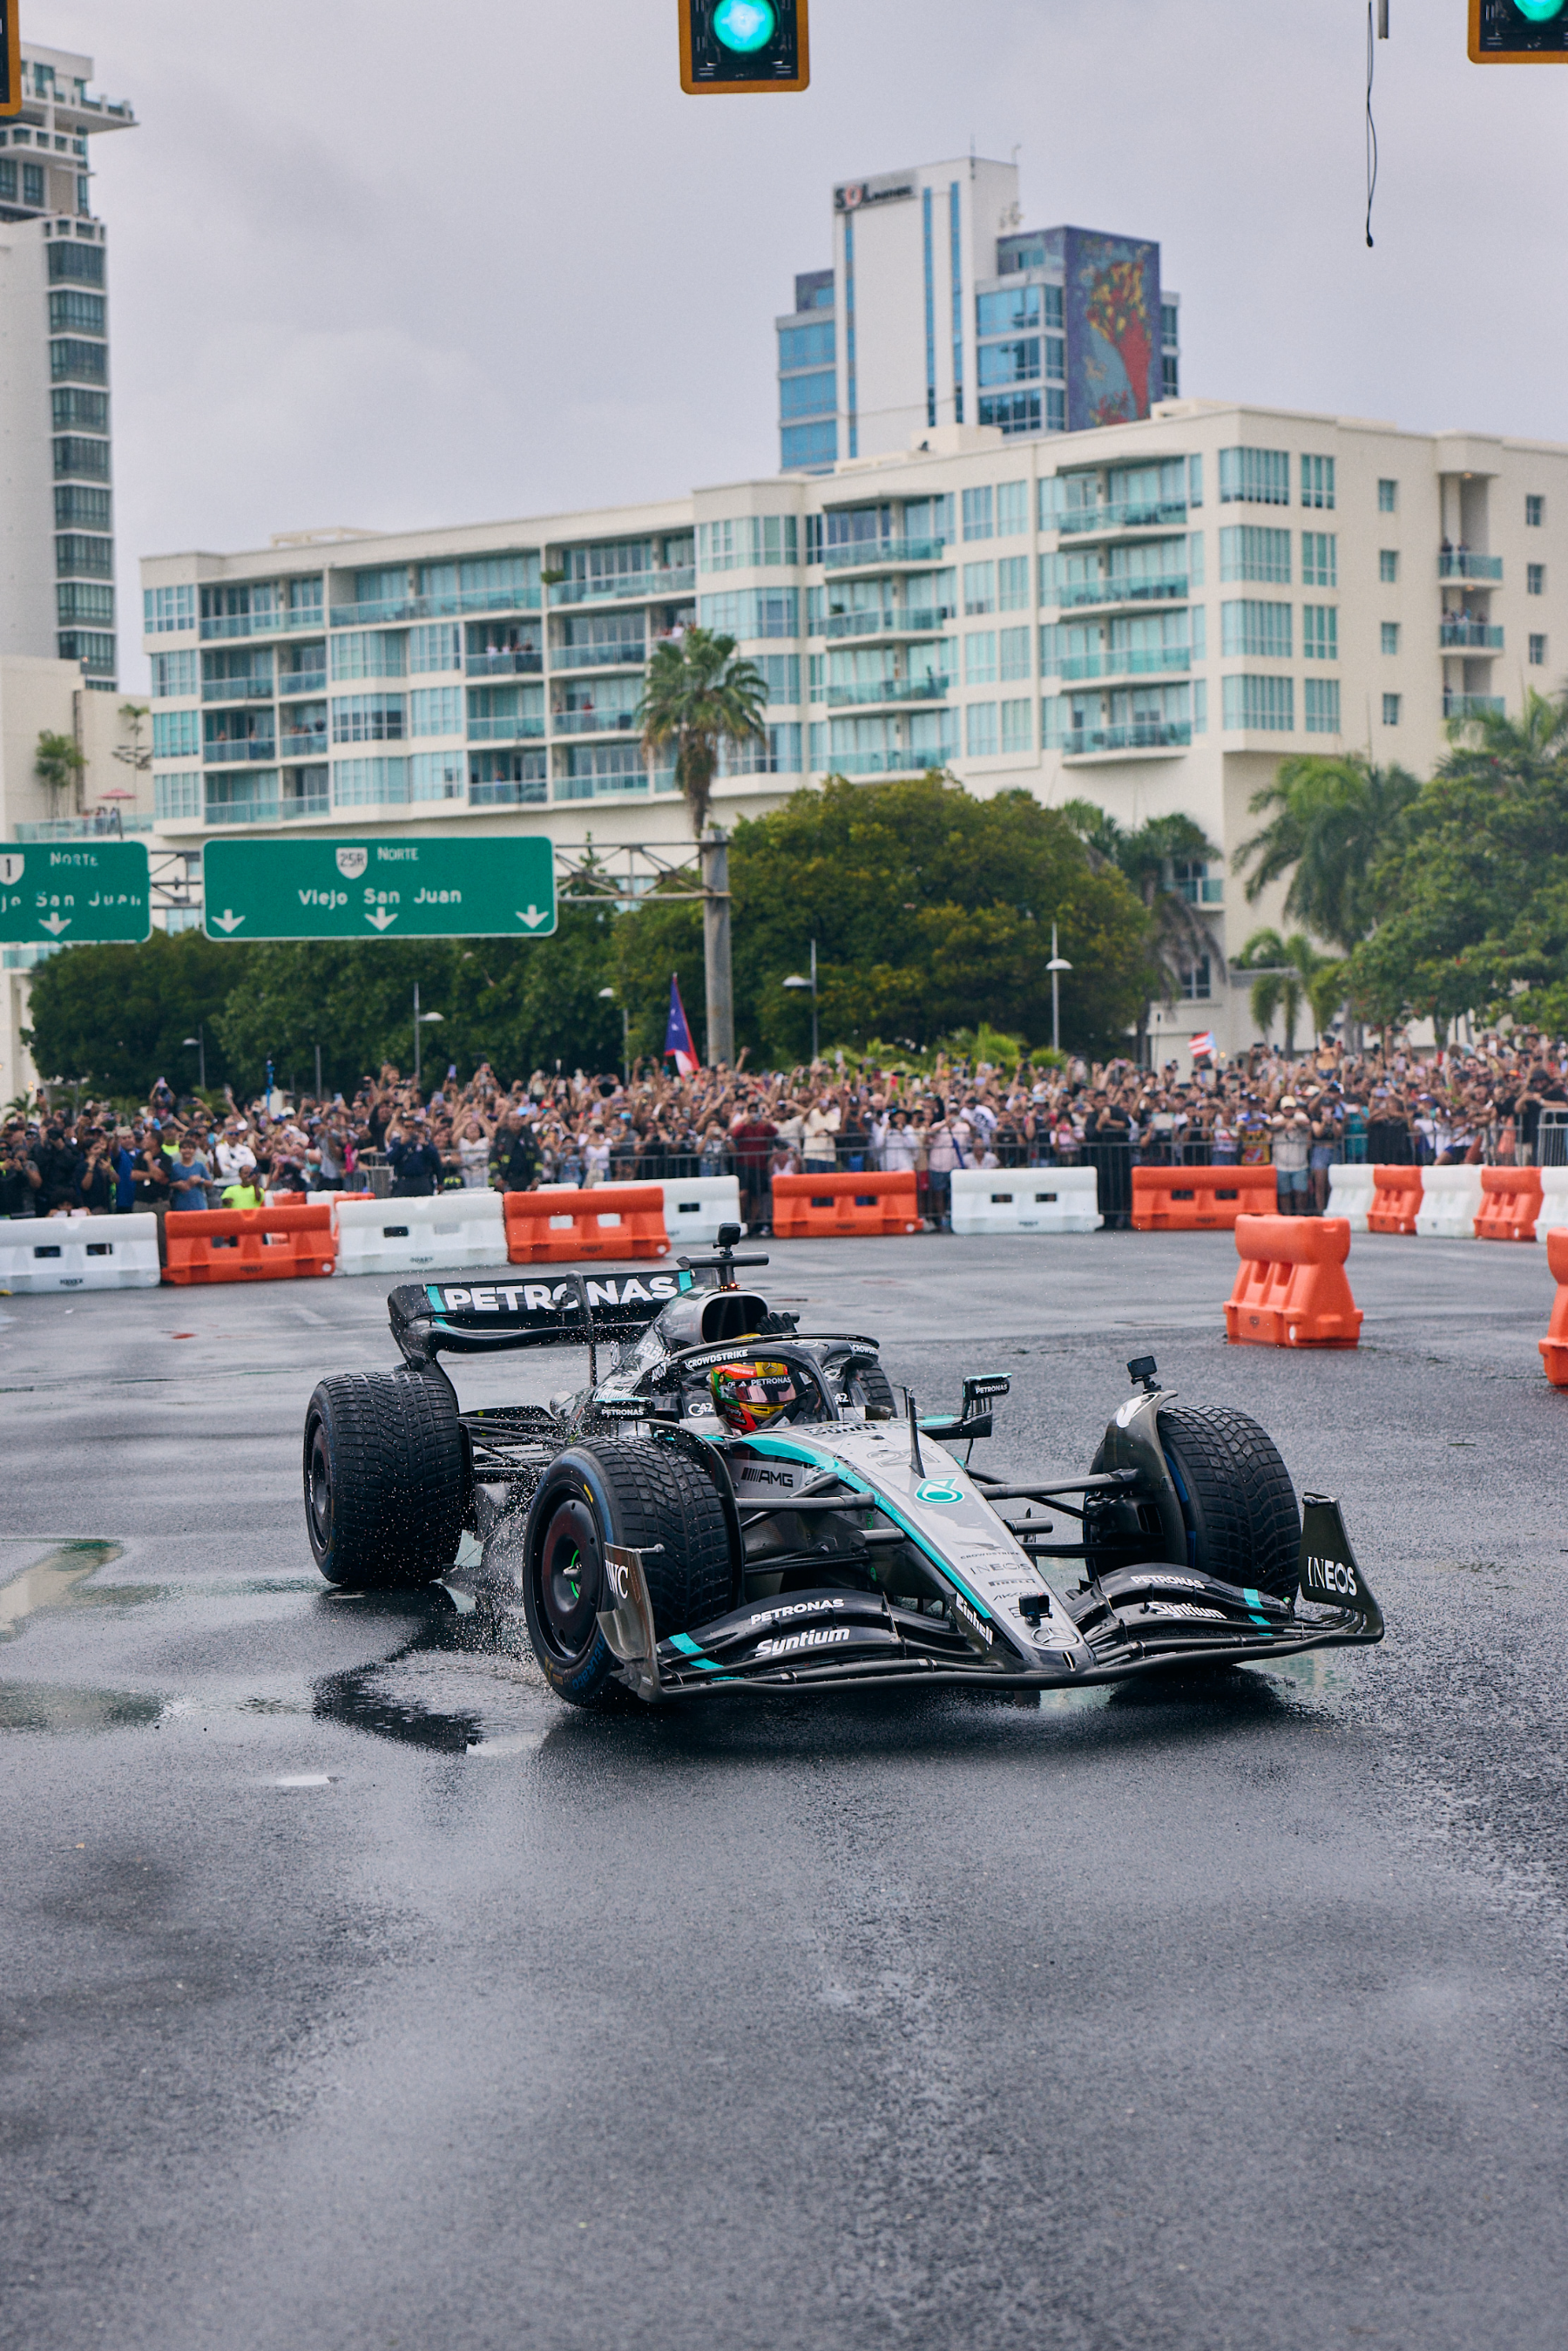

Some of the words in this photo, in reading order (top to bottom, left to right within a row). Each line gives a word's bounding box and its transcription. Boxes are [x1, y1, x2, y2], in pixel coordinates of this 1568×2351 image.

[50, 851, 98, 867] NORTE
[376, 846, 420, 861] NORTE
[6, 858, 11, 877] 1
[35, 891, 75, 907] San
[298, 889, 348, 910] Viejo
[363, 887, 401, 904] San
[413, 886, 463, 904] Juan
[686, 1348, 749, 1369] CROWDSTRIKE
[751, 1377, 792, 1386] PETRONAS
[976, 1384, 1008, 1394] PETRONAS
[834, 1393, 849, 1406] 42
[601, 1408, 645, 1417] PETRONAS
[687, 1403, 714, 1417] G42
[759, 1469, 794, 1487] AMG
[960, 1551, 1020, 1560] CROWDSTRIKE
[970, 1562, 1032, 1575] INEOS
[1308, 1555, 1358, 1596] INEOS
[1130, 1575, 1206, 1589] PETRONAS
[750, 1598, 845, 1625] PETRONAS
[1146, 1602, 1227, 1619] Syntium
[754, 1628, 850, 1657] Syntium
